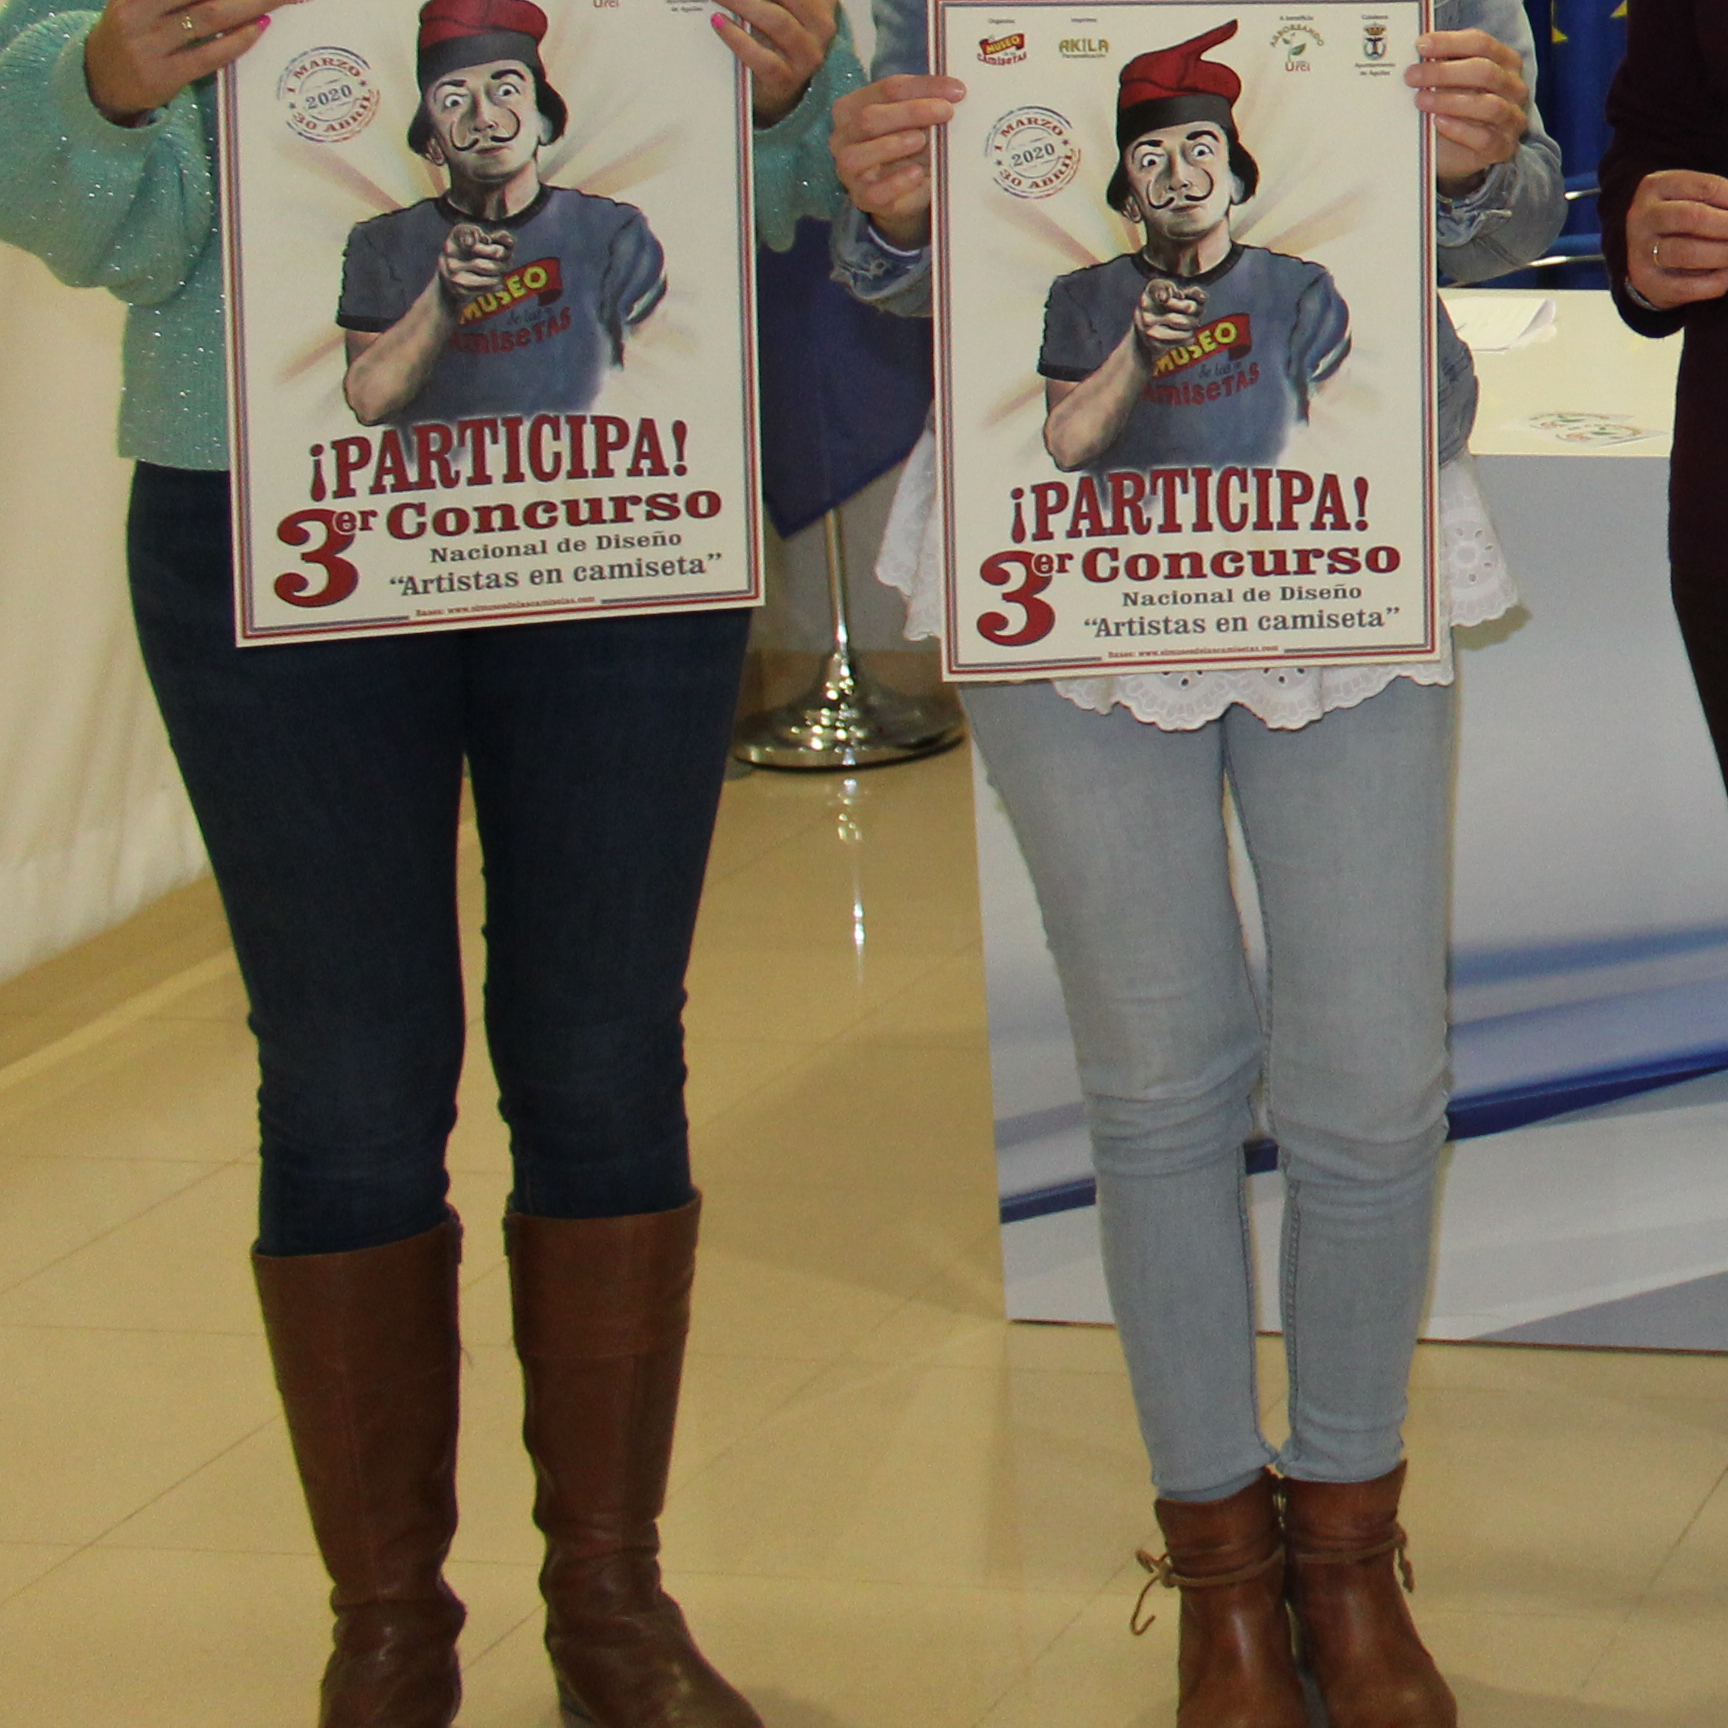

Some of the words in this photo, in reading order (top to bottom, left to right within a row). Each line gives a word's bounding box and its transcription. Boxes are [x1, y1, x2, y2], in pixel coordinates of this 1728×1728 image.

[1059, 38, 1109, 53] AKILA
[293, 57, 362, 80] MARZO
[291, 111, 318, 131] 30
[324, 89, 375, 133] ABRIL
[305, 84, 353, 110] 2020
[1000, 117, 1064, 137] MARZO
[999, 169, 1022, 187] 30
[1027, 148, 1074, 189] ABRIL
[1011, 143, 1055, 166] 2020
[459, 266, 549, 325] MUSEO
[1153, 321, 1238, 377] MUSEO
[309, 413, 689, 502] ¡PARTICIPA!
[386, 489, 722, 540] Concurso
[1010, 466, 1369, 544] ¡PARTICIPA!
[430, 540, 547, 563] Nacional
[557, 537, 587, 553] de
[596, 531, 682, 550] Diseño
[1081, 544, 1401, 584] Concurso
[389, 568, 519, 596] “Artistas
[530, 567, 562, 585] en
[574, 552, 722, 582] camiseta”
[1122, 588, 1233, 607] Nacional
[1243, 587, 1270, 602] de
[1280, 583, 1362, 601] Diseño
[1084, 616, 1206, 638] “Artistas
[1216, 614, 1248, 632] en
[1258, 606, 1400, 631] camiseta”
